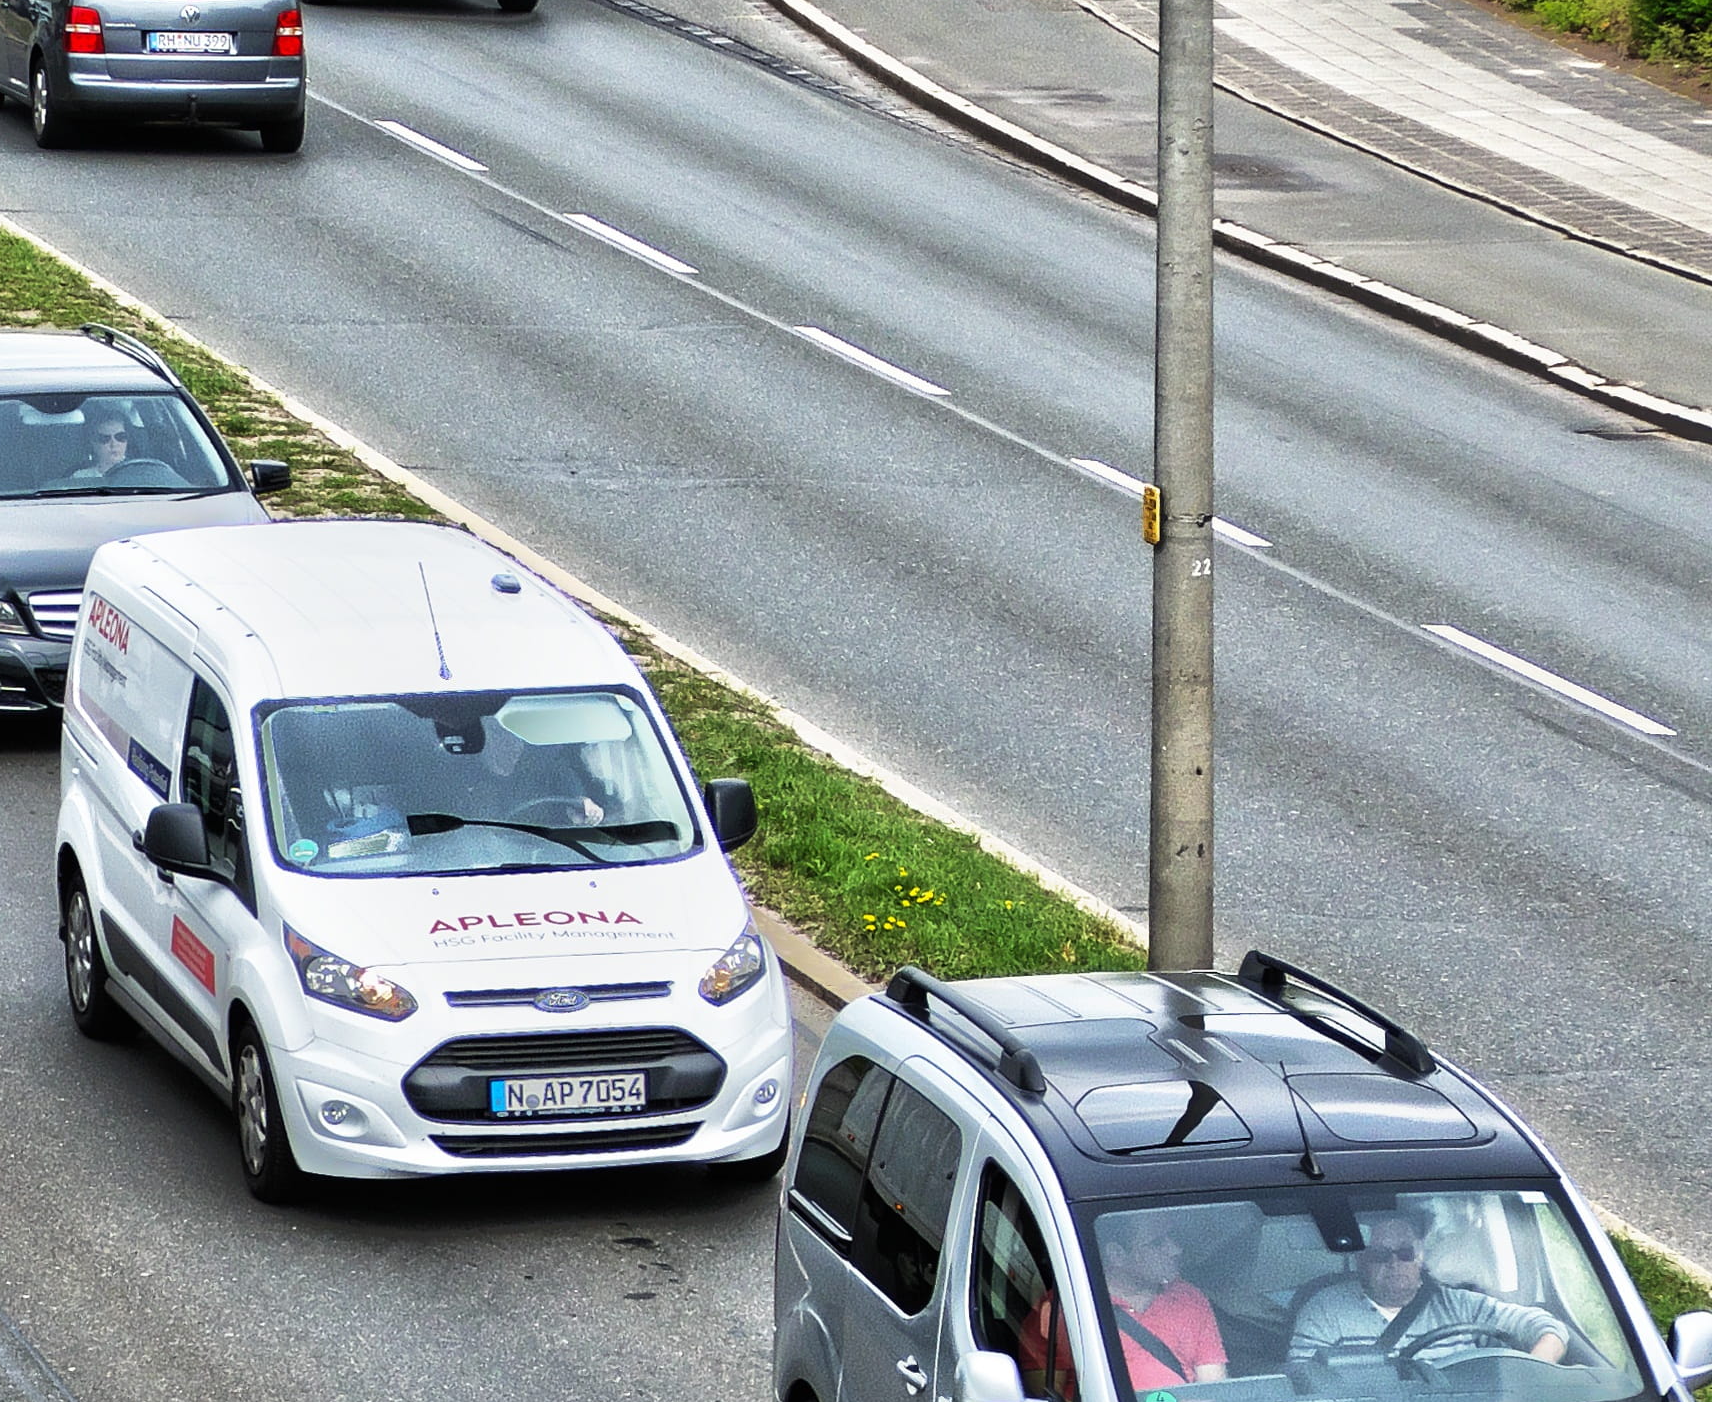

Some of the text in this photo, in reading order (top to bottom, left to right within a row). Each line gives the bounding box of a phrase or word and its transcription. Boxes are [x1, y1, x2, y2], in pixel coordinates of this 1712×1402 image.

[158, 34, 227, 47] RH NU 399
[88, 597, 130, 655] APLEONA
[429, 910, 644, 934] APLEONA
[433, 929, 677, 949] HSG Facility Management
[507, 1076, 643, 1108] N AP 7054
